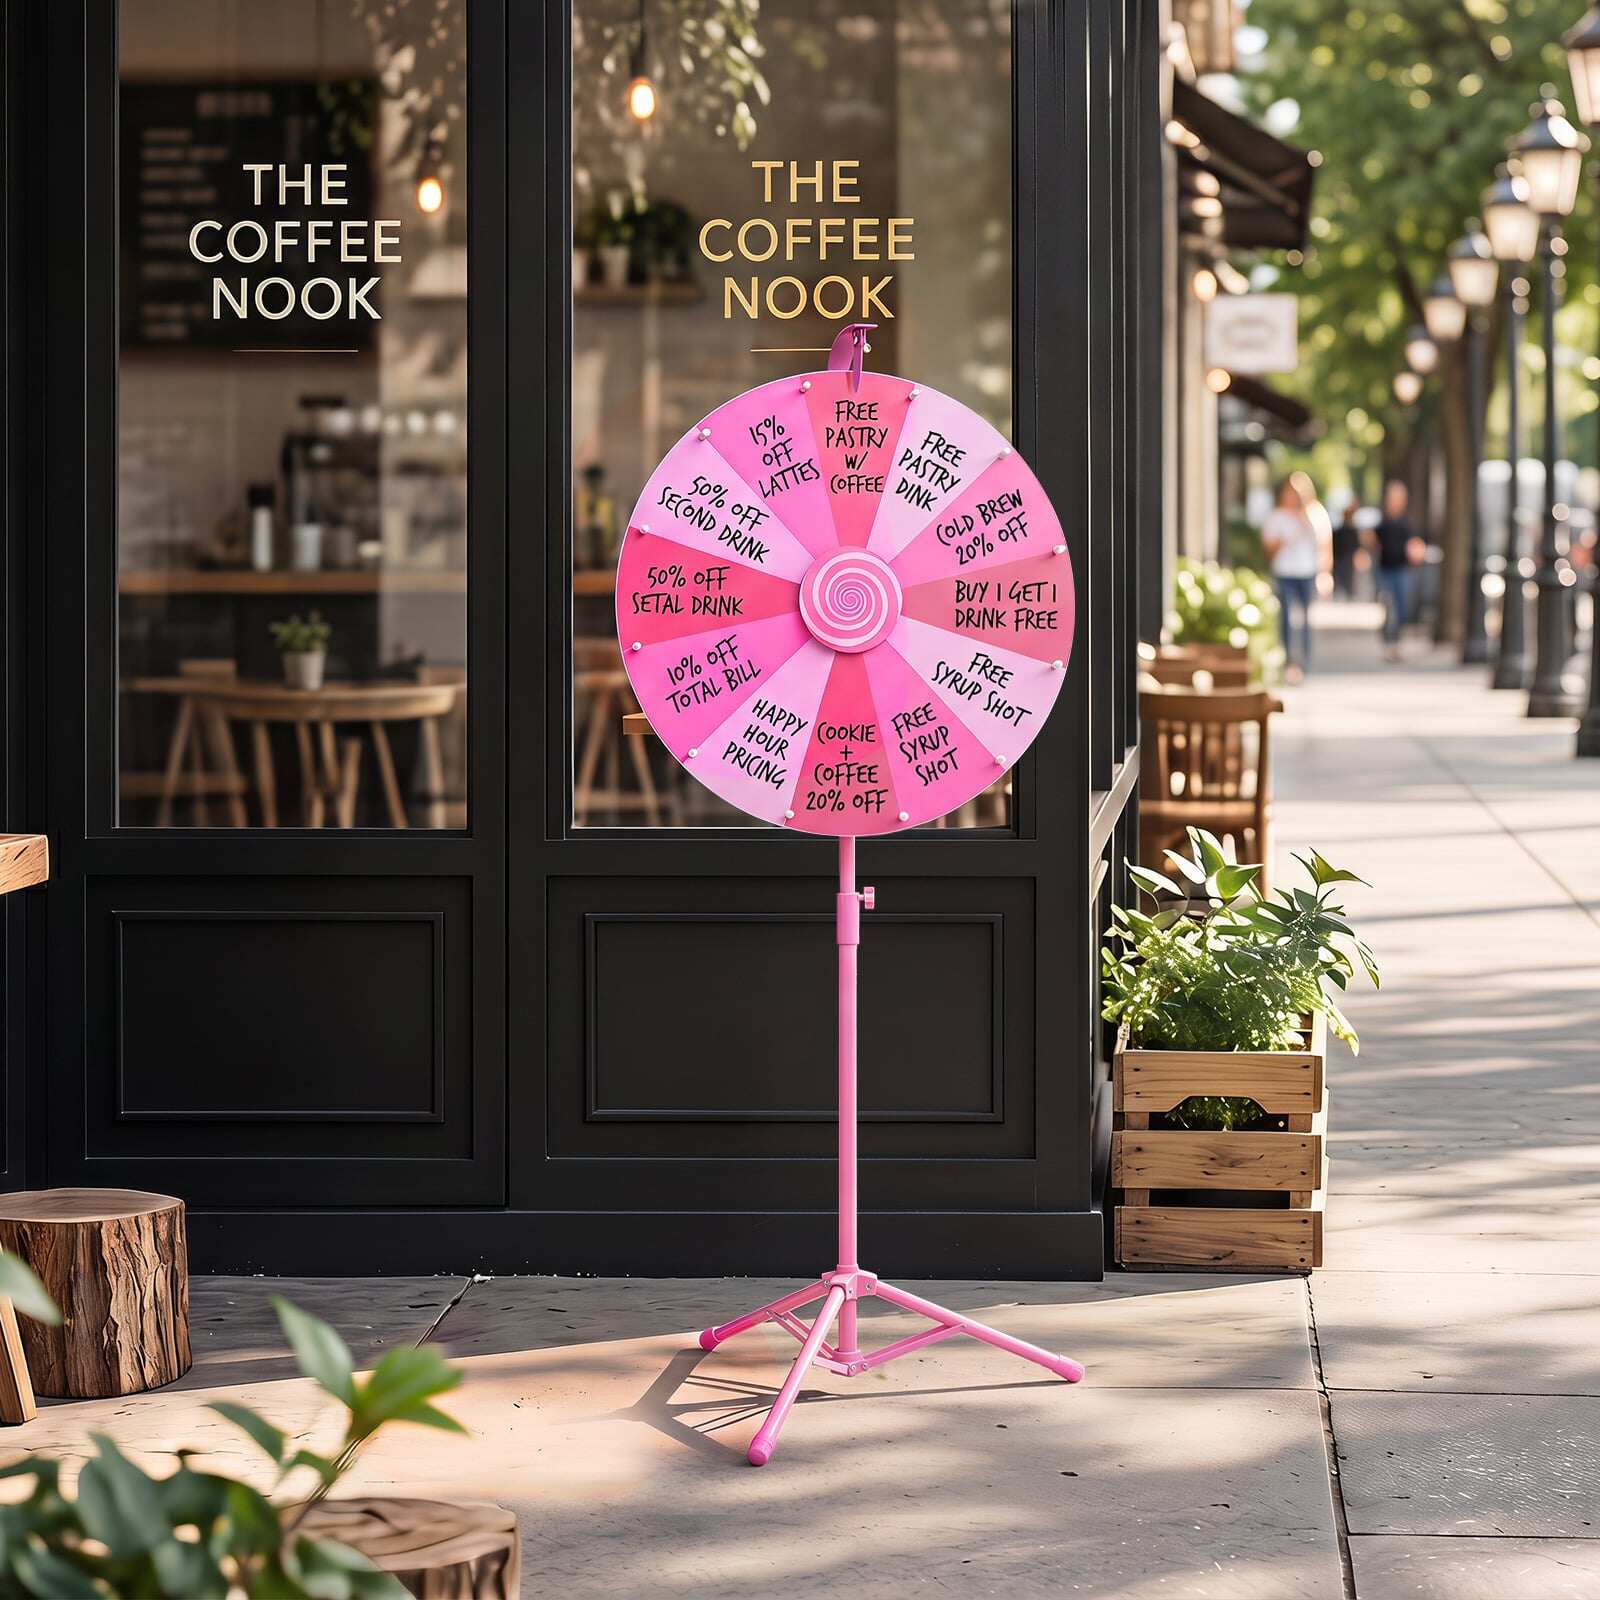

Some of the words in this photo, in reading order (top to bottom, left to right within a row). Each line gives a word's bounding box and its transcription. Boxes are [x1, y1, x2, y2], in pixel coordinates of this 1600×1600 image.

[243, 164, 348, 205] THE
[752, 160, 860, 202] THE
[189, 220, 402, 263] COFFEE
[699, 218, 915, 262] COFFEE
[212, 277, 382, 320] NOOK
[723, 275, 895, 319] NOOK
[836, 400, 879, 423] FREE
[749, 415, 785, 446] 15%
[826, 426, 888, 448] PASTRY
[763, 438, 792, 467] OFF
[845, 451, 869, 470] W/
[921, 431, 967, 468] FREE
[759, 458, 820, 498] LATTES
[830, 474, 884, 495] COFFEE
[898, 448, 961, 493] PASTRY
[688, 476, 728, 508] 50%
[732, 503, 769, 531] OFF
[896, 477, 938, 512] DINK
[657, 487, 716, 531] SECOND
[718, 525, 770, 564] DRINK
[936, 515, 975, 546] COLD
[976, 488, 1023, 526] BREW
[956, 532, 994, 566] 20%
[999, 512, 1028, 544] OFF
[648, 565, 686, 588] 50%
[694, 566, 731, 591] OFF
[955, 580, 989, 603] BUY
[1008, 581, 1049, 604] GET
[632, 592, 684, 615] SETAL
[692, 596, 744, 616] DRINK
[955, 608, 1006, 631] DRINK
[1014, 608, 1058, 632] FREE
[666, 655, 702, 686] 10%
[707, 634, 738, 667] OFF
[968, 652, 1014, 689] FREE
[666, 678, 722, 713] TOTAL
[722, 660, 762, 692] BILL
[932, 661, 982, 700] SYRUP
[983, 690, 1032, 728] SHOT
[752, 698, 808, 737] HAPPY
[817, 721, 876, 744] COOKIE
[890, 702, 937, 739] FREE
[743, 724, 789, 761] HOUR
[840, 745, 854, 761] +
[899, 725, 949, 763] SYRUP
[722, 741, 787, 790] PRICING
[814, 762, 879, 786] COFFEE
[915, 748, 958, 786] SHOT
[806, 789, 845, 812] 20%
[852, 788, 888, 814] OFF
